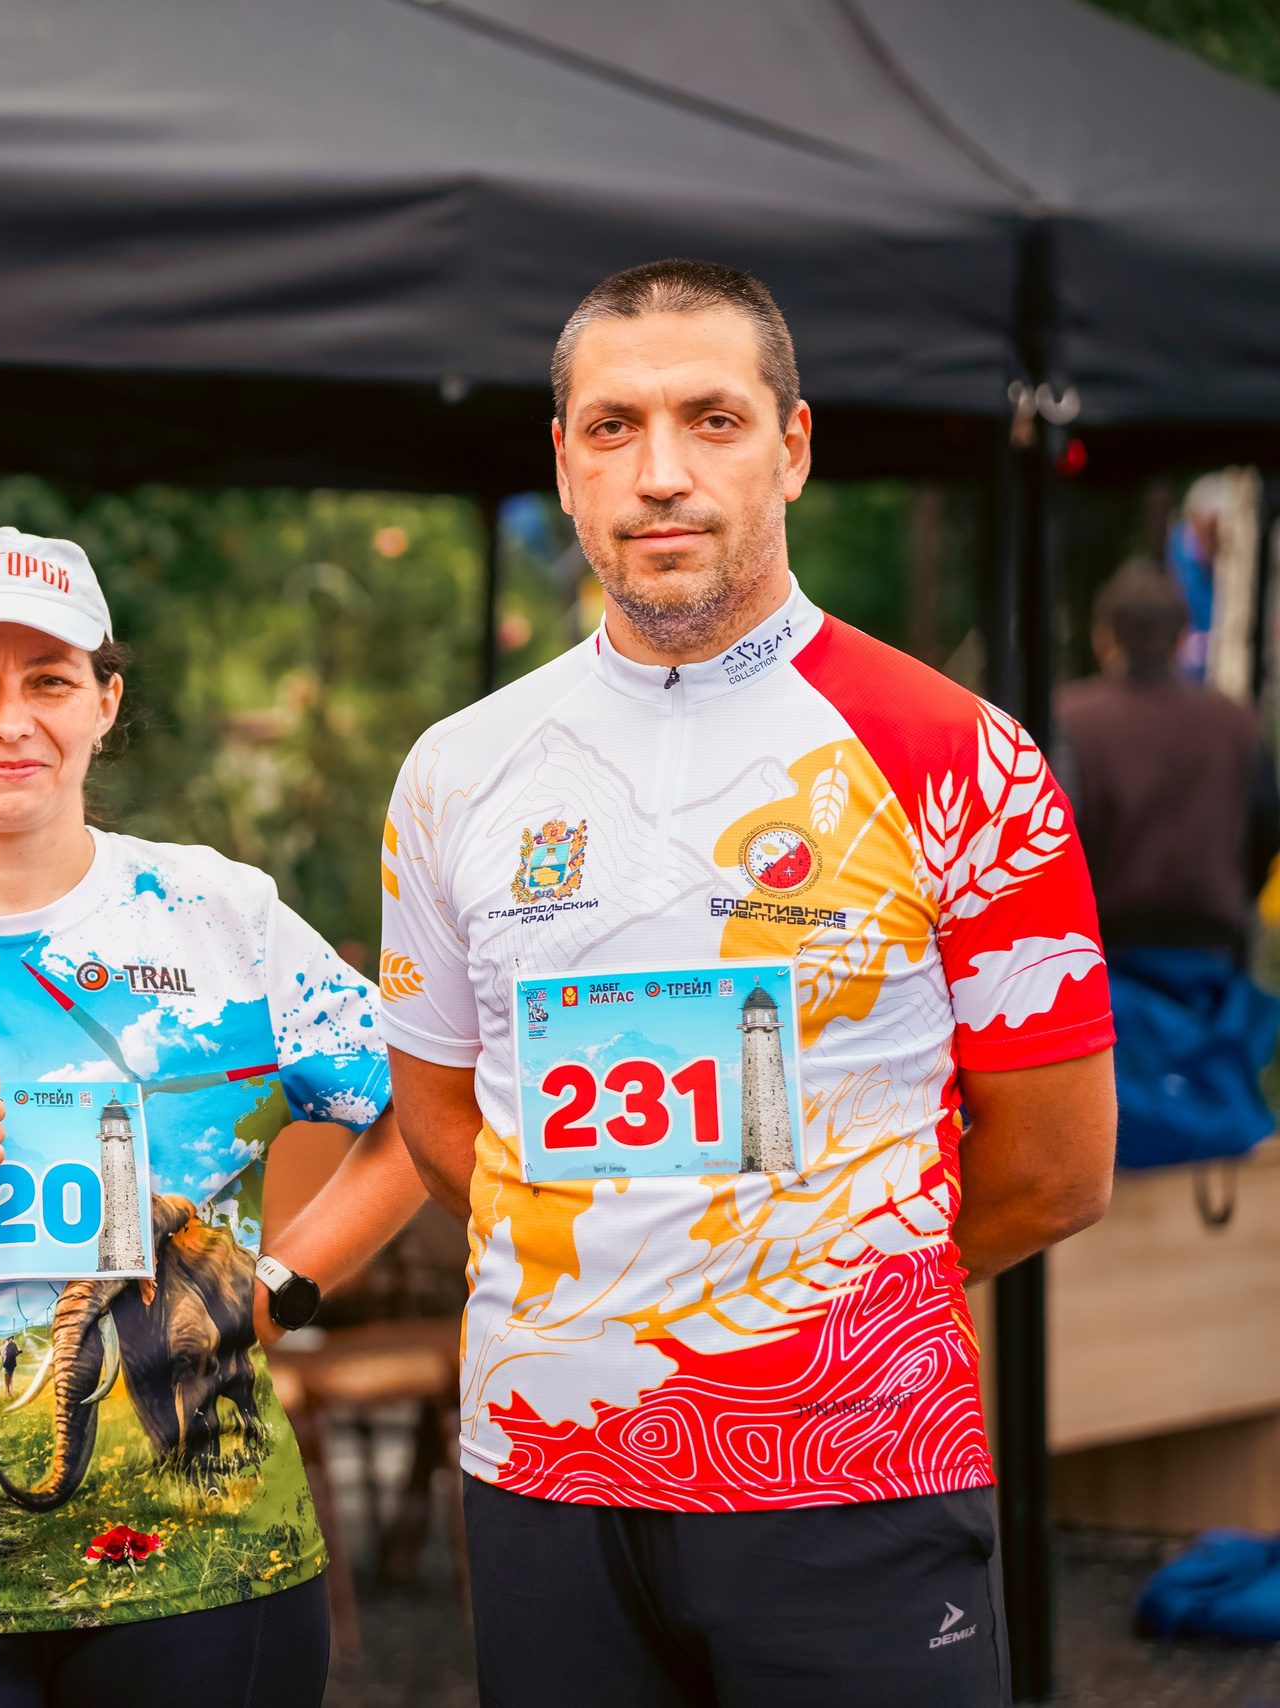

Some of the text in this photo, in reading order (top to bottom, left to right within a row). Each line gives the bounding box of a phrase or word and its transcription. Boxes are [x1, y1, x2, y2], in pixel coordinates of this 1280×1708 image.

[725, 661, 748, 676] TEAM
[729, 655, 778, 685] COLLECTION
[488, 898, 599, 919] СТАВРОПОЛЬСКИЙ
[521, 911, 554, 924] КРАЙ
[528, 990, 547, 999] 2026
[589, 982, 620, 993] ЗАБЕГ
[589, 991, 635, 1004] МАГАС
[541, 1059, 720, 1150] 231
[791, 1391, 915, 1419] DYNAMICKNIT
[929, 1623, 977, 1649] DEMIX
